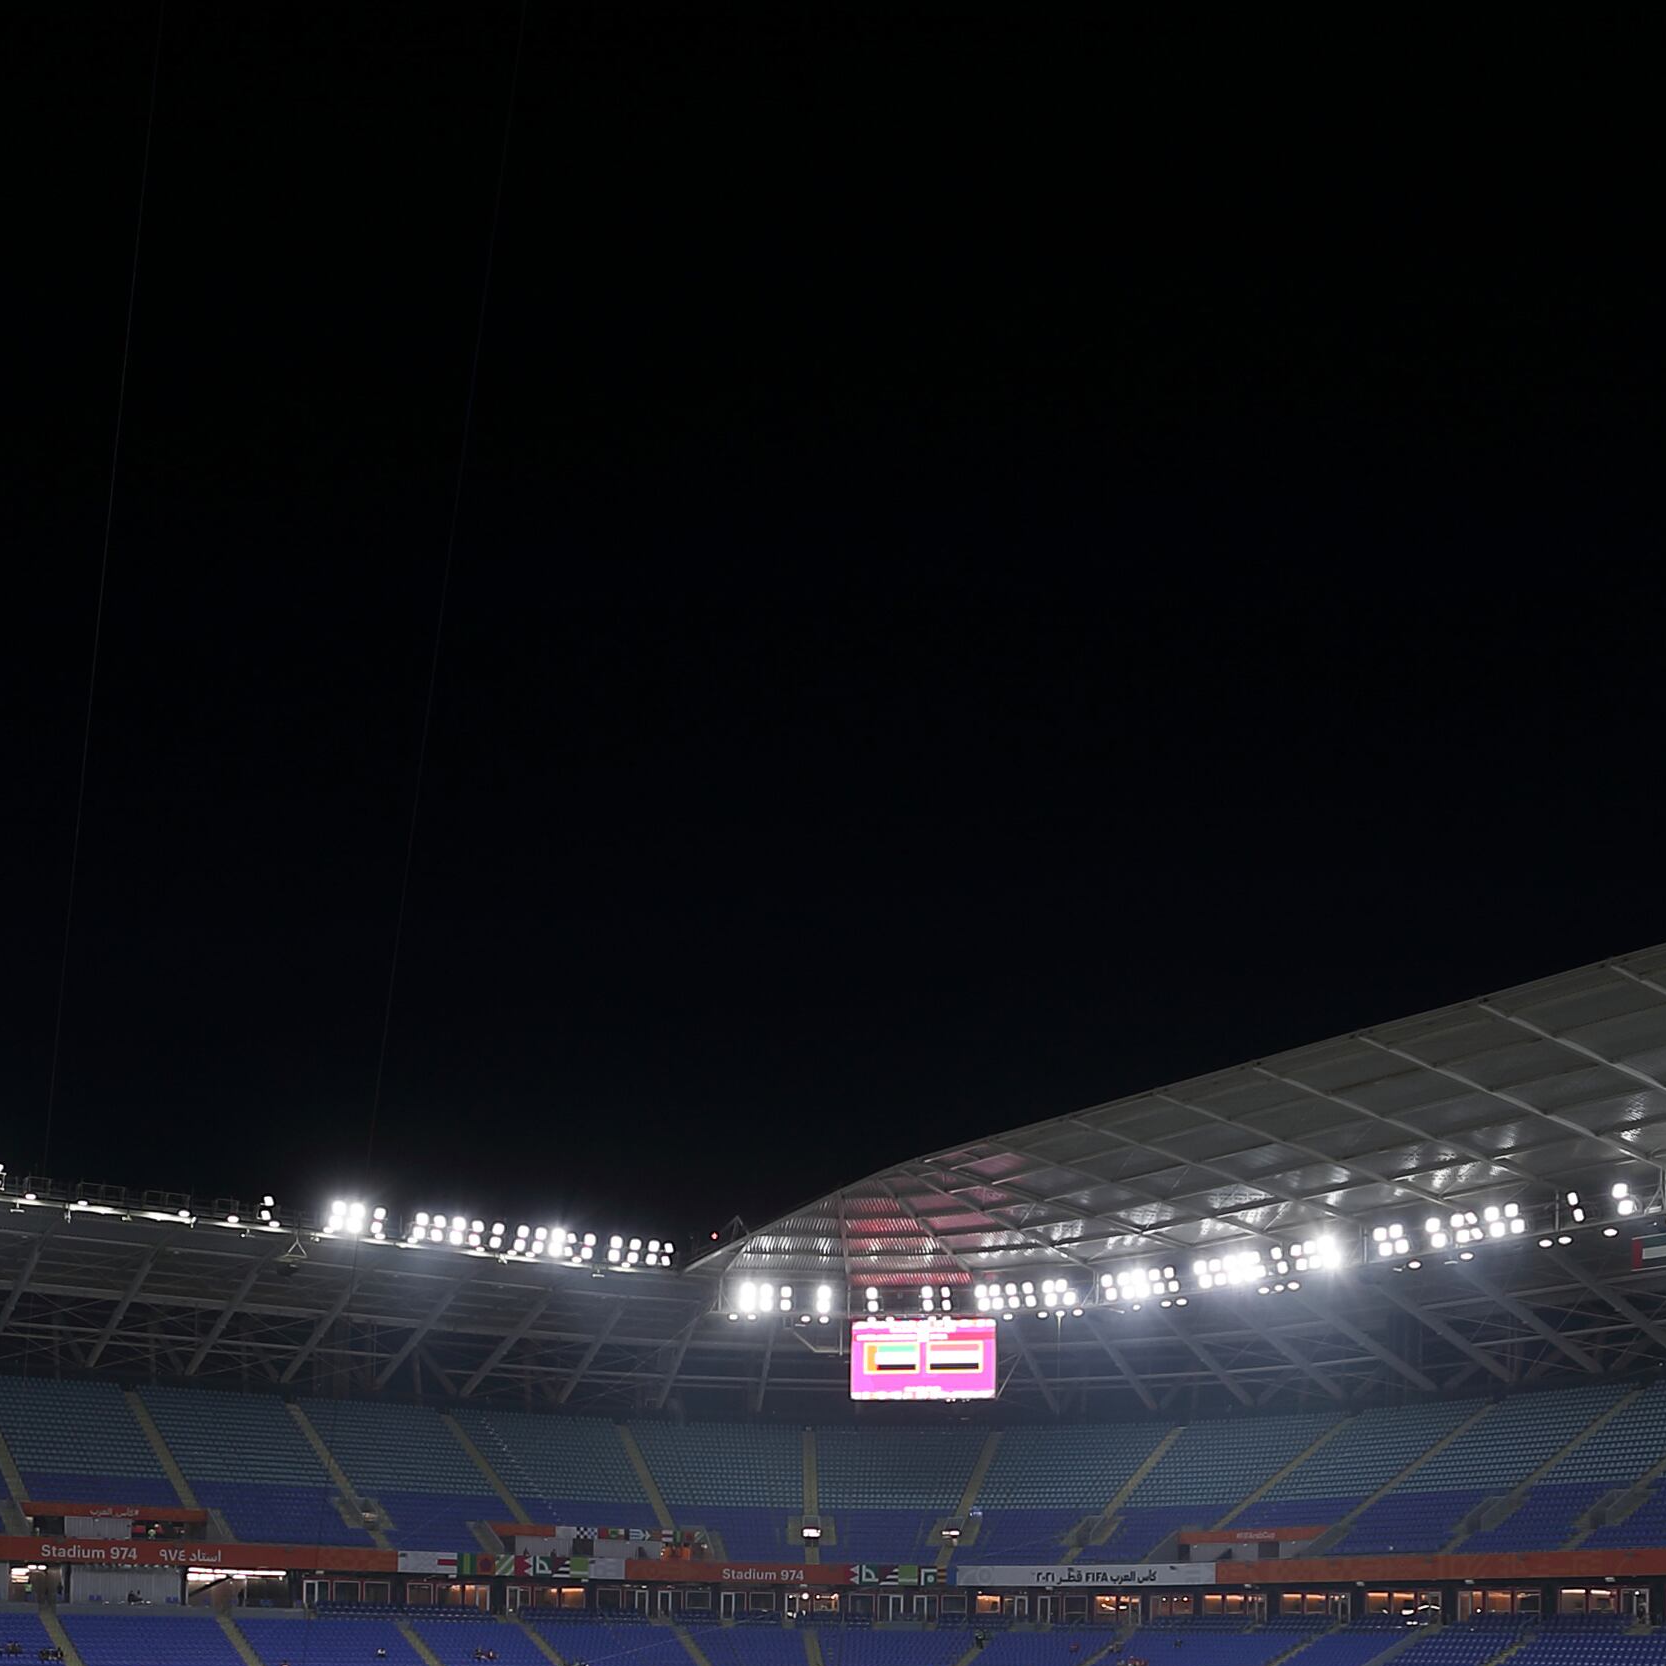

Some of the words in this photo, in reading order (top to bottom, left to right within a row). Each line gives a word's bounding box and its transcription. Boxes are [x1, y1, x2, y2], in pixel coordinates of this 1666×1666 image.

[40, 1544, 105, 1559] Stadium
[110, 1546, 137, 1560] 974
[159, 1549, 186, 1562] ٩٧٤
[188, 1550, 222, 1563] استاد
[722, 1568, 777, 1580] Stadium
[780, 1569, 804, 1581] 974
[1085, 1572, 1109, 1582] FIFA
[1110, 1570, 1136, 1585] العرب
[1137, 1569, 1157, 1584] كأس
